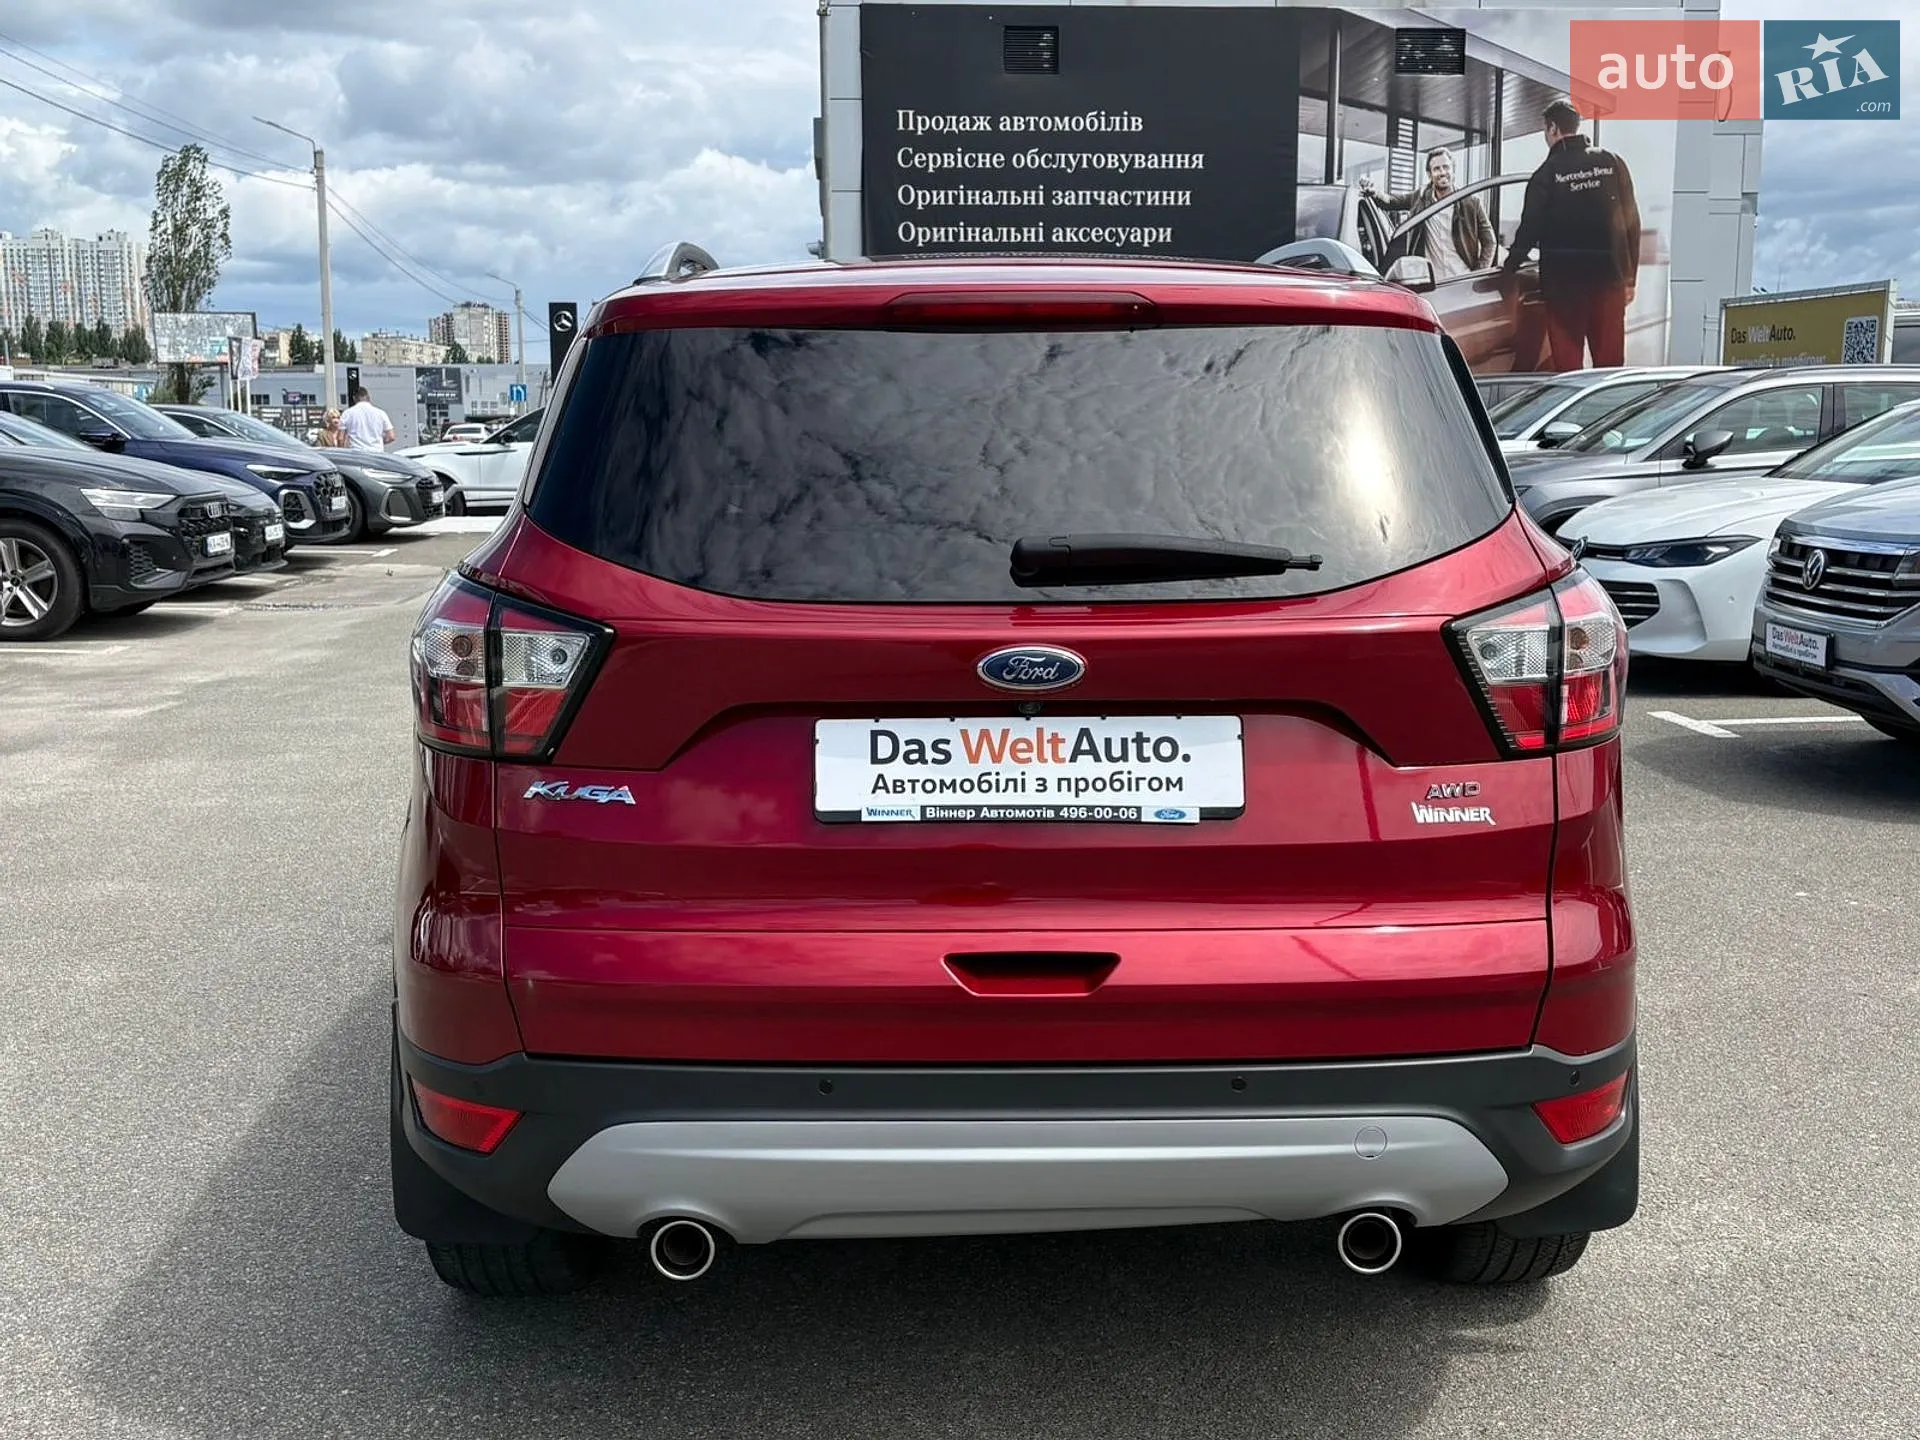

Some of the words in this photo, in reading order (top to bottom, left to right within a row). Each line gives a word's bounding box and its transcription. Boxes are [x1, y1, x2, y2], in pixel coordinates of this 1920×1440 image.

[897, 110, 992, 135] Продаж
[999, 110, 1144, 132] автомобілів
[897, 146, 1005, 172] Сервісне
[1012, 148, 1205, 173] обслуговування
[897, 184, 1045, 209] Оригінальні
[1052, 188, 1191, 207] запчастини
[1570, 180, 1600, 192] Service
[897, 221, 1045, 246] Оригінальні
[1052, 226, 1172, 247] аксесуари
[1731, 328, 1746, 344] Das
[1002, 656, 1060, 680] Ford
[871, 729, 952, 765] Das
[523, 781, 636, 804] KUGA
[871, 772, 1026, 794] Автомобілі
[1035, 778, 1048, 793] з
[1057, 770, 1184, 798] пробігом
[1425, 781, 1481, 800] AWD
[866, 806, 915, 820] WINNER
[926, 806, 976, 820] Віннер
[980, 806, 1055, 819] Автомотів
[1059, 806, 1138, 820] 496-00-06
